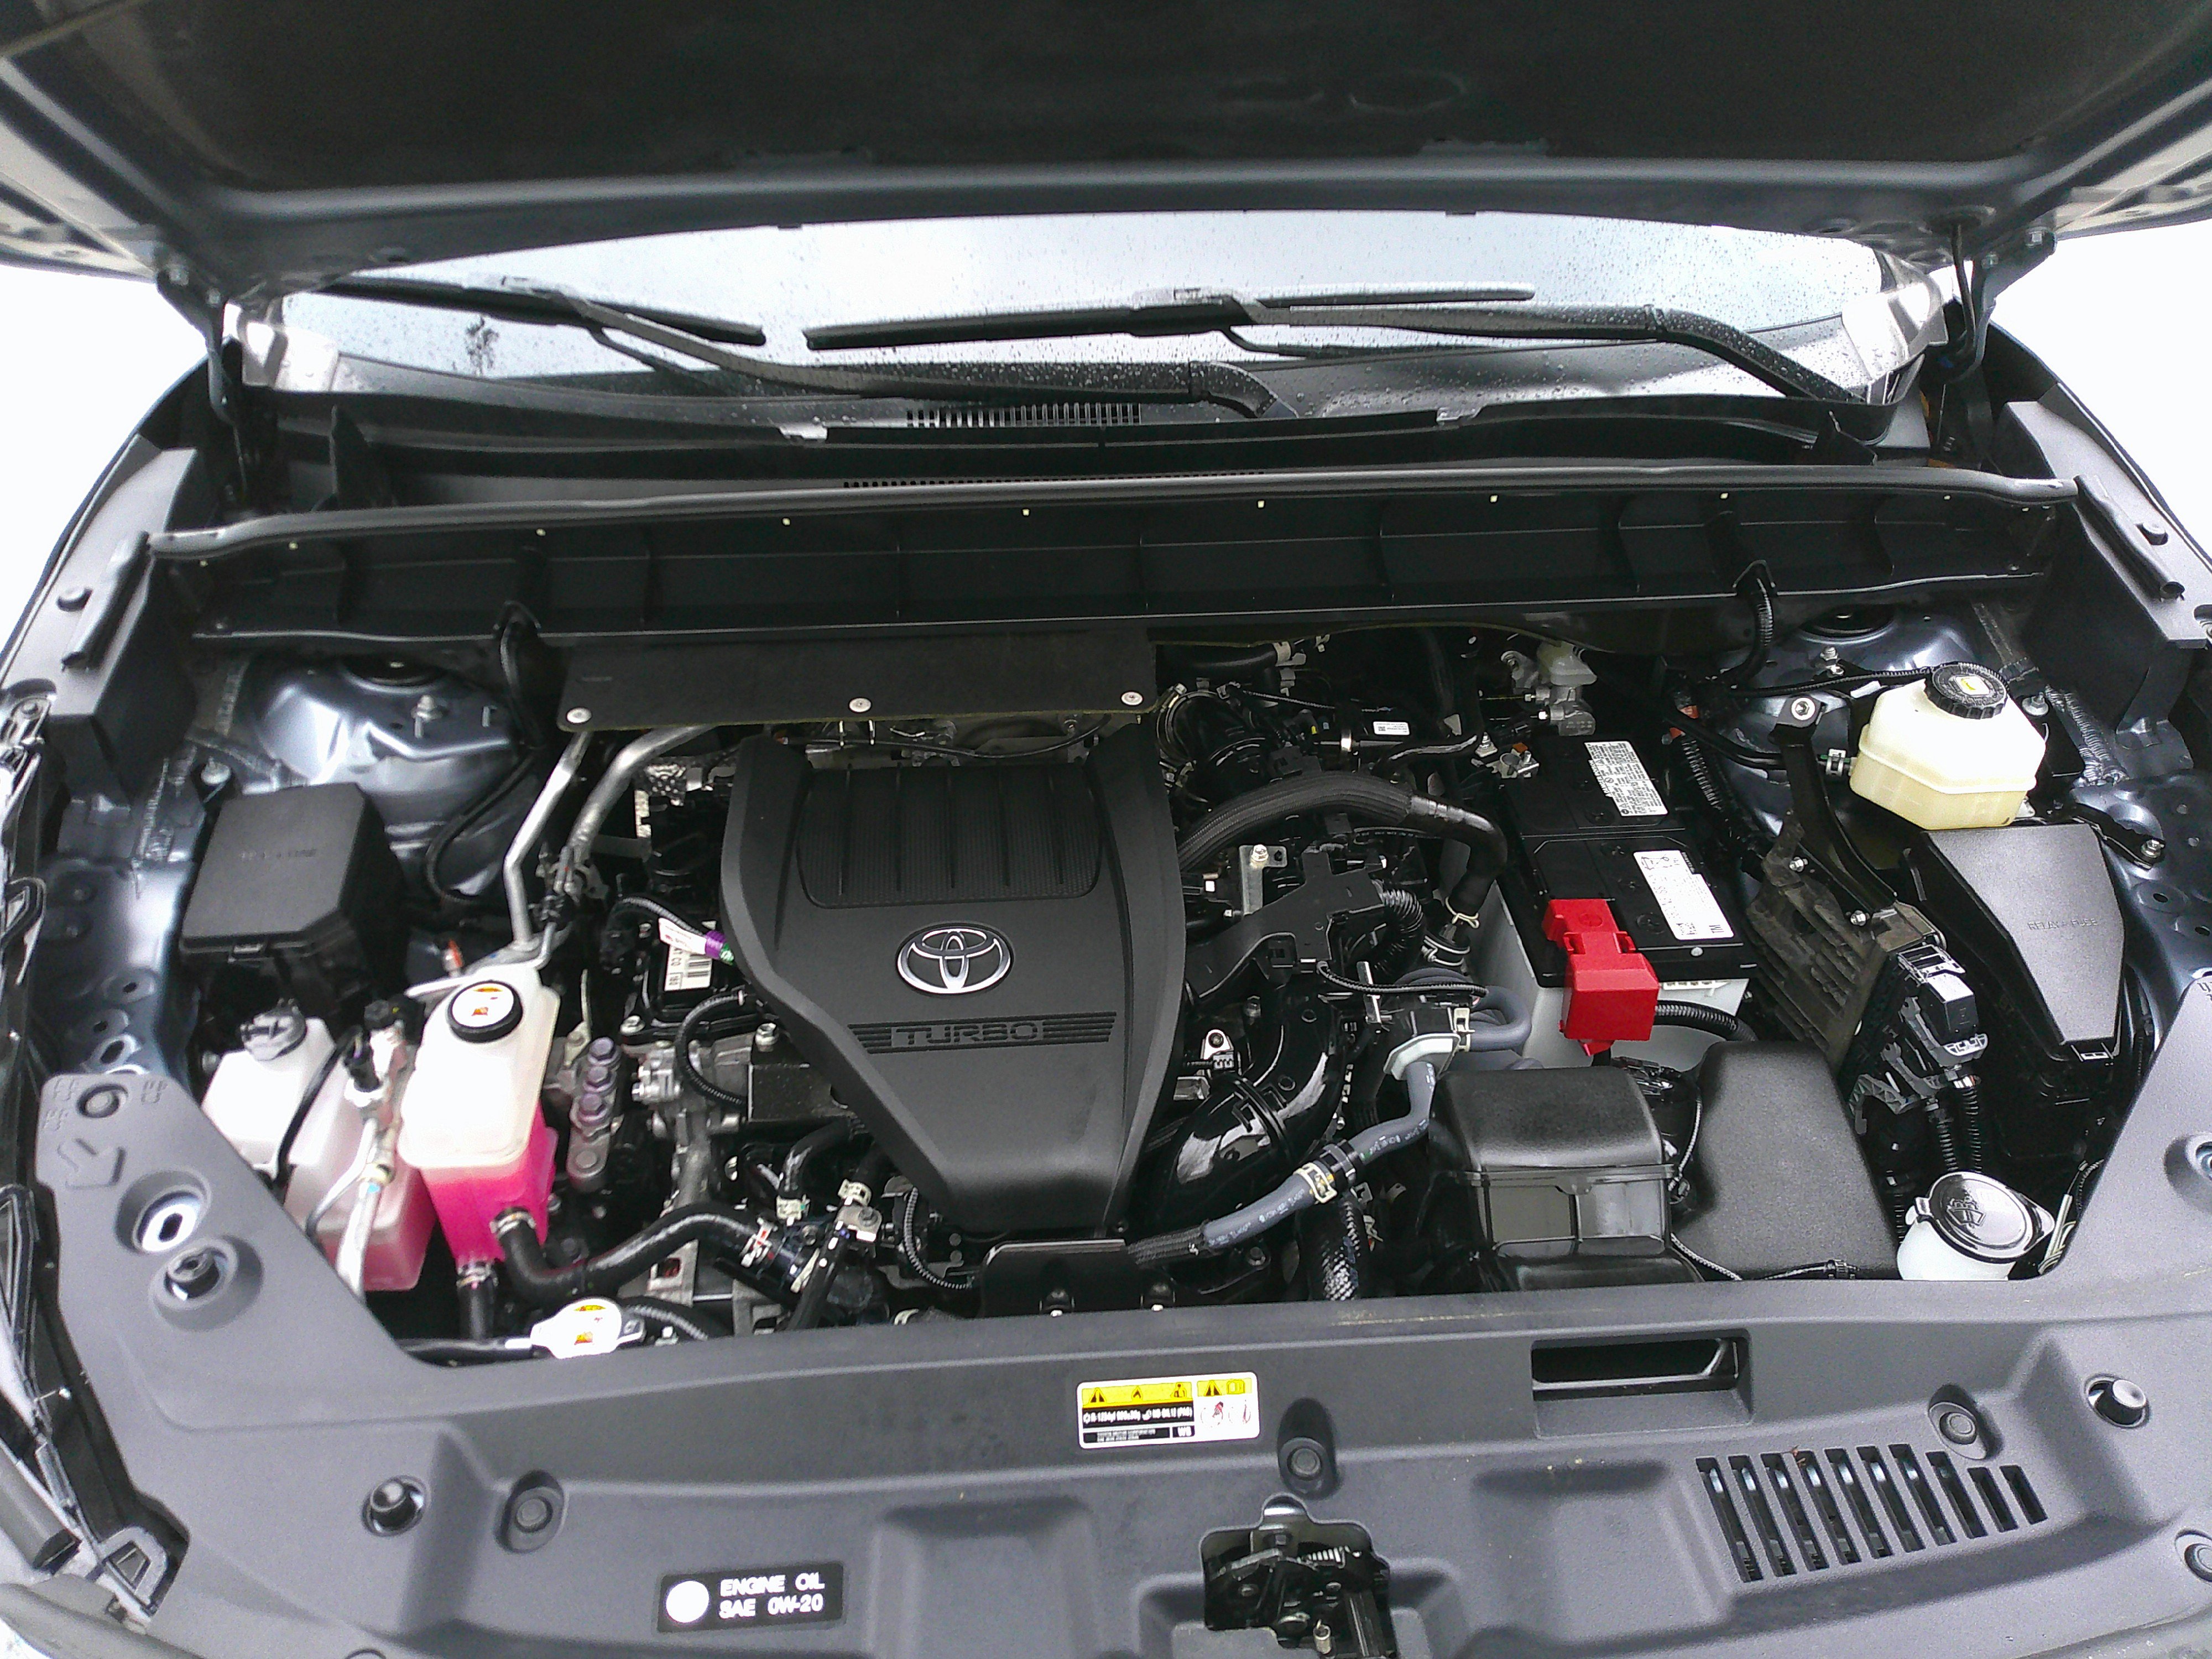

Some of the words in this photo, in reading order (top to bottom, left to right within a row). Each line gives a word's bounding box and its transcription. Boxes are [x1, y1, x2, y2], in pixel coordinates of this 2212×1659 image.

[895, 1021, 1038, 1045] TURBO
[720, 1575, 785, 1597] ENGINE
[795, 1572, 826, 1592] OIL
[719, 1598, 756, 1619] SAE
